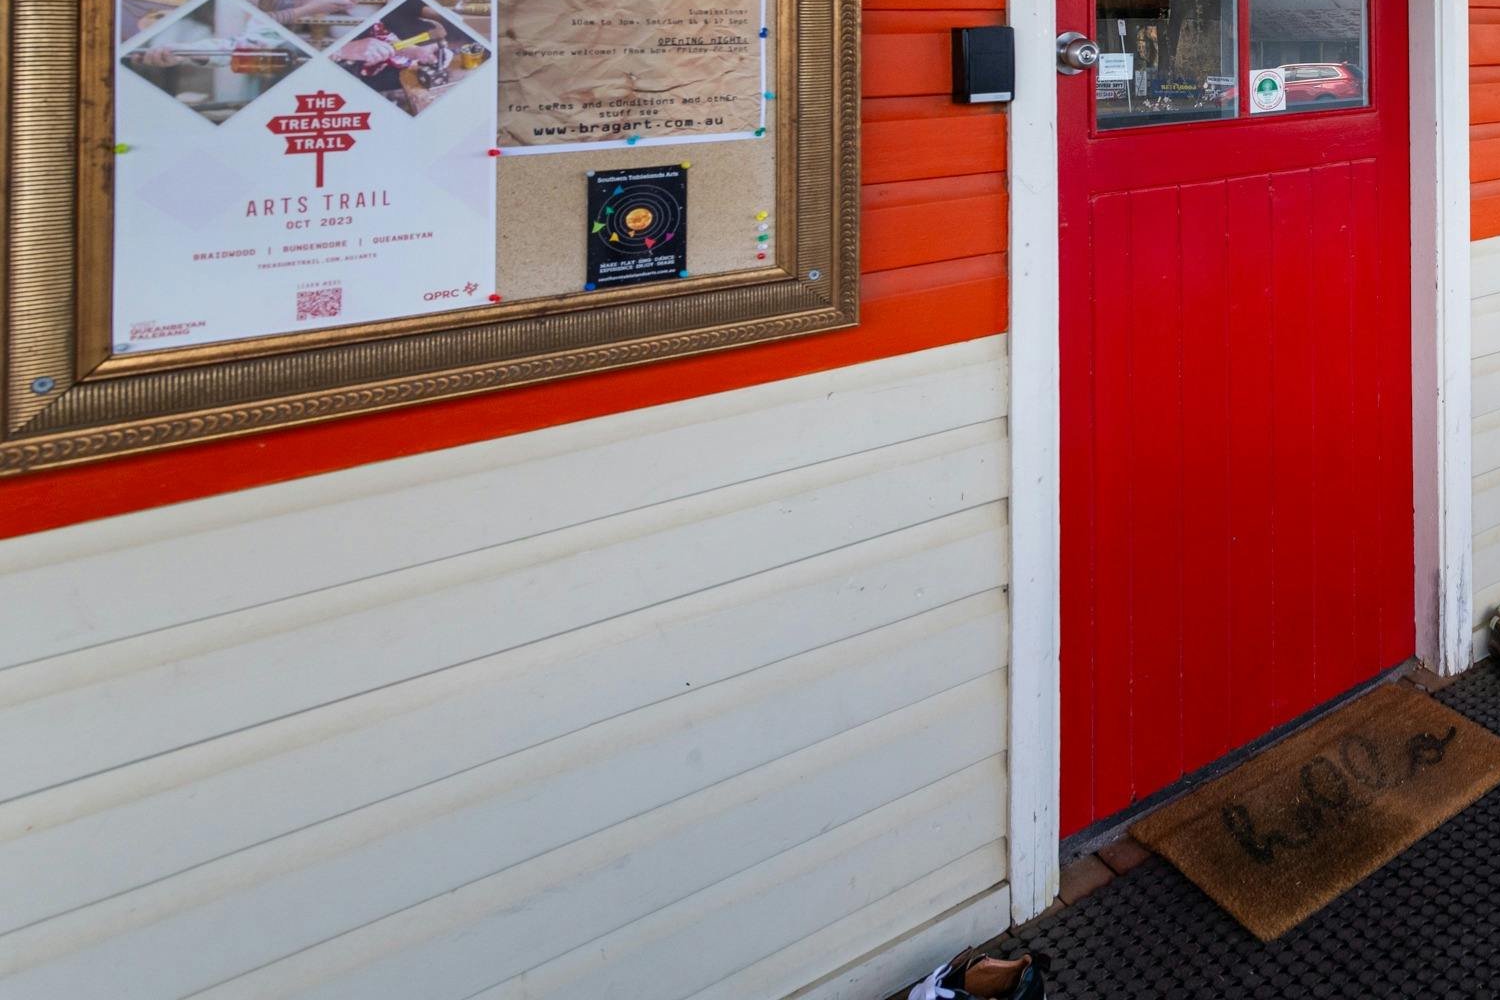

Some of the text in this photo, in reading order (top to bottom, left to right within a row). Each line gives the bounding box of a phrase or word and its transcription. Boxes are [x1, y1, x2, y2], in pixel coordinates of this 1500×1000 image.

[305, 96, 335, 109] THE
[508, 103, 529, 113] for
[581, 100, 602, 110] and
[599, 109, 632, 119] stuff
[279, 115, 362, 130] TREASURE
[533, 116, 724, 136] www.bragart.com.au
[294, 137, 346, 150] TRAIL
[246, 189, 391, 218] ARTS TRAIL
[286, 216, 353, 230] OCT 2023
[193, 231, 433, 261] BRAIDWOOD BUNGENDORE QUEANBEYAN
[423, 288, 460, 301] QPRC
